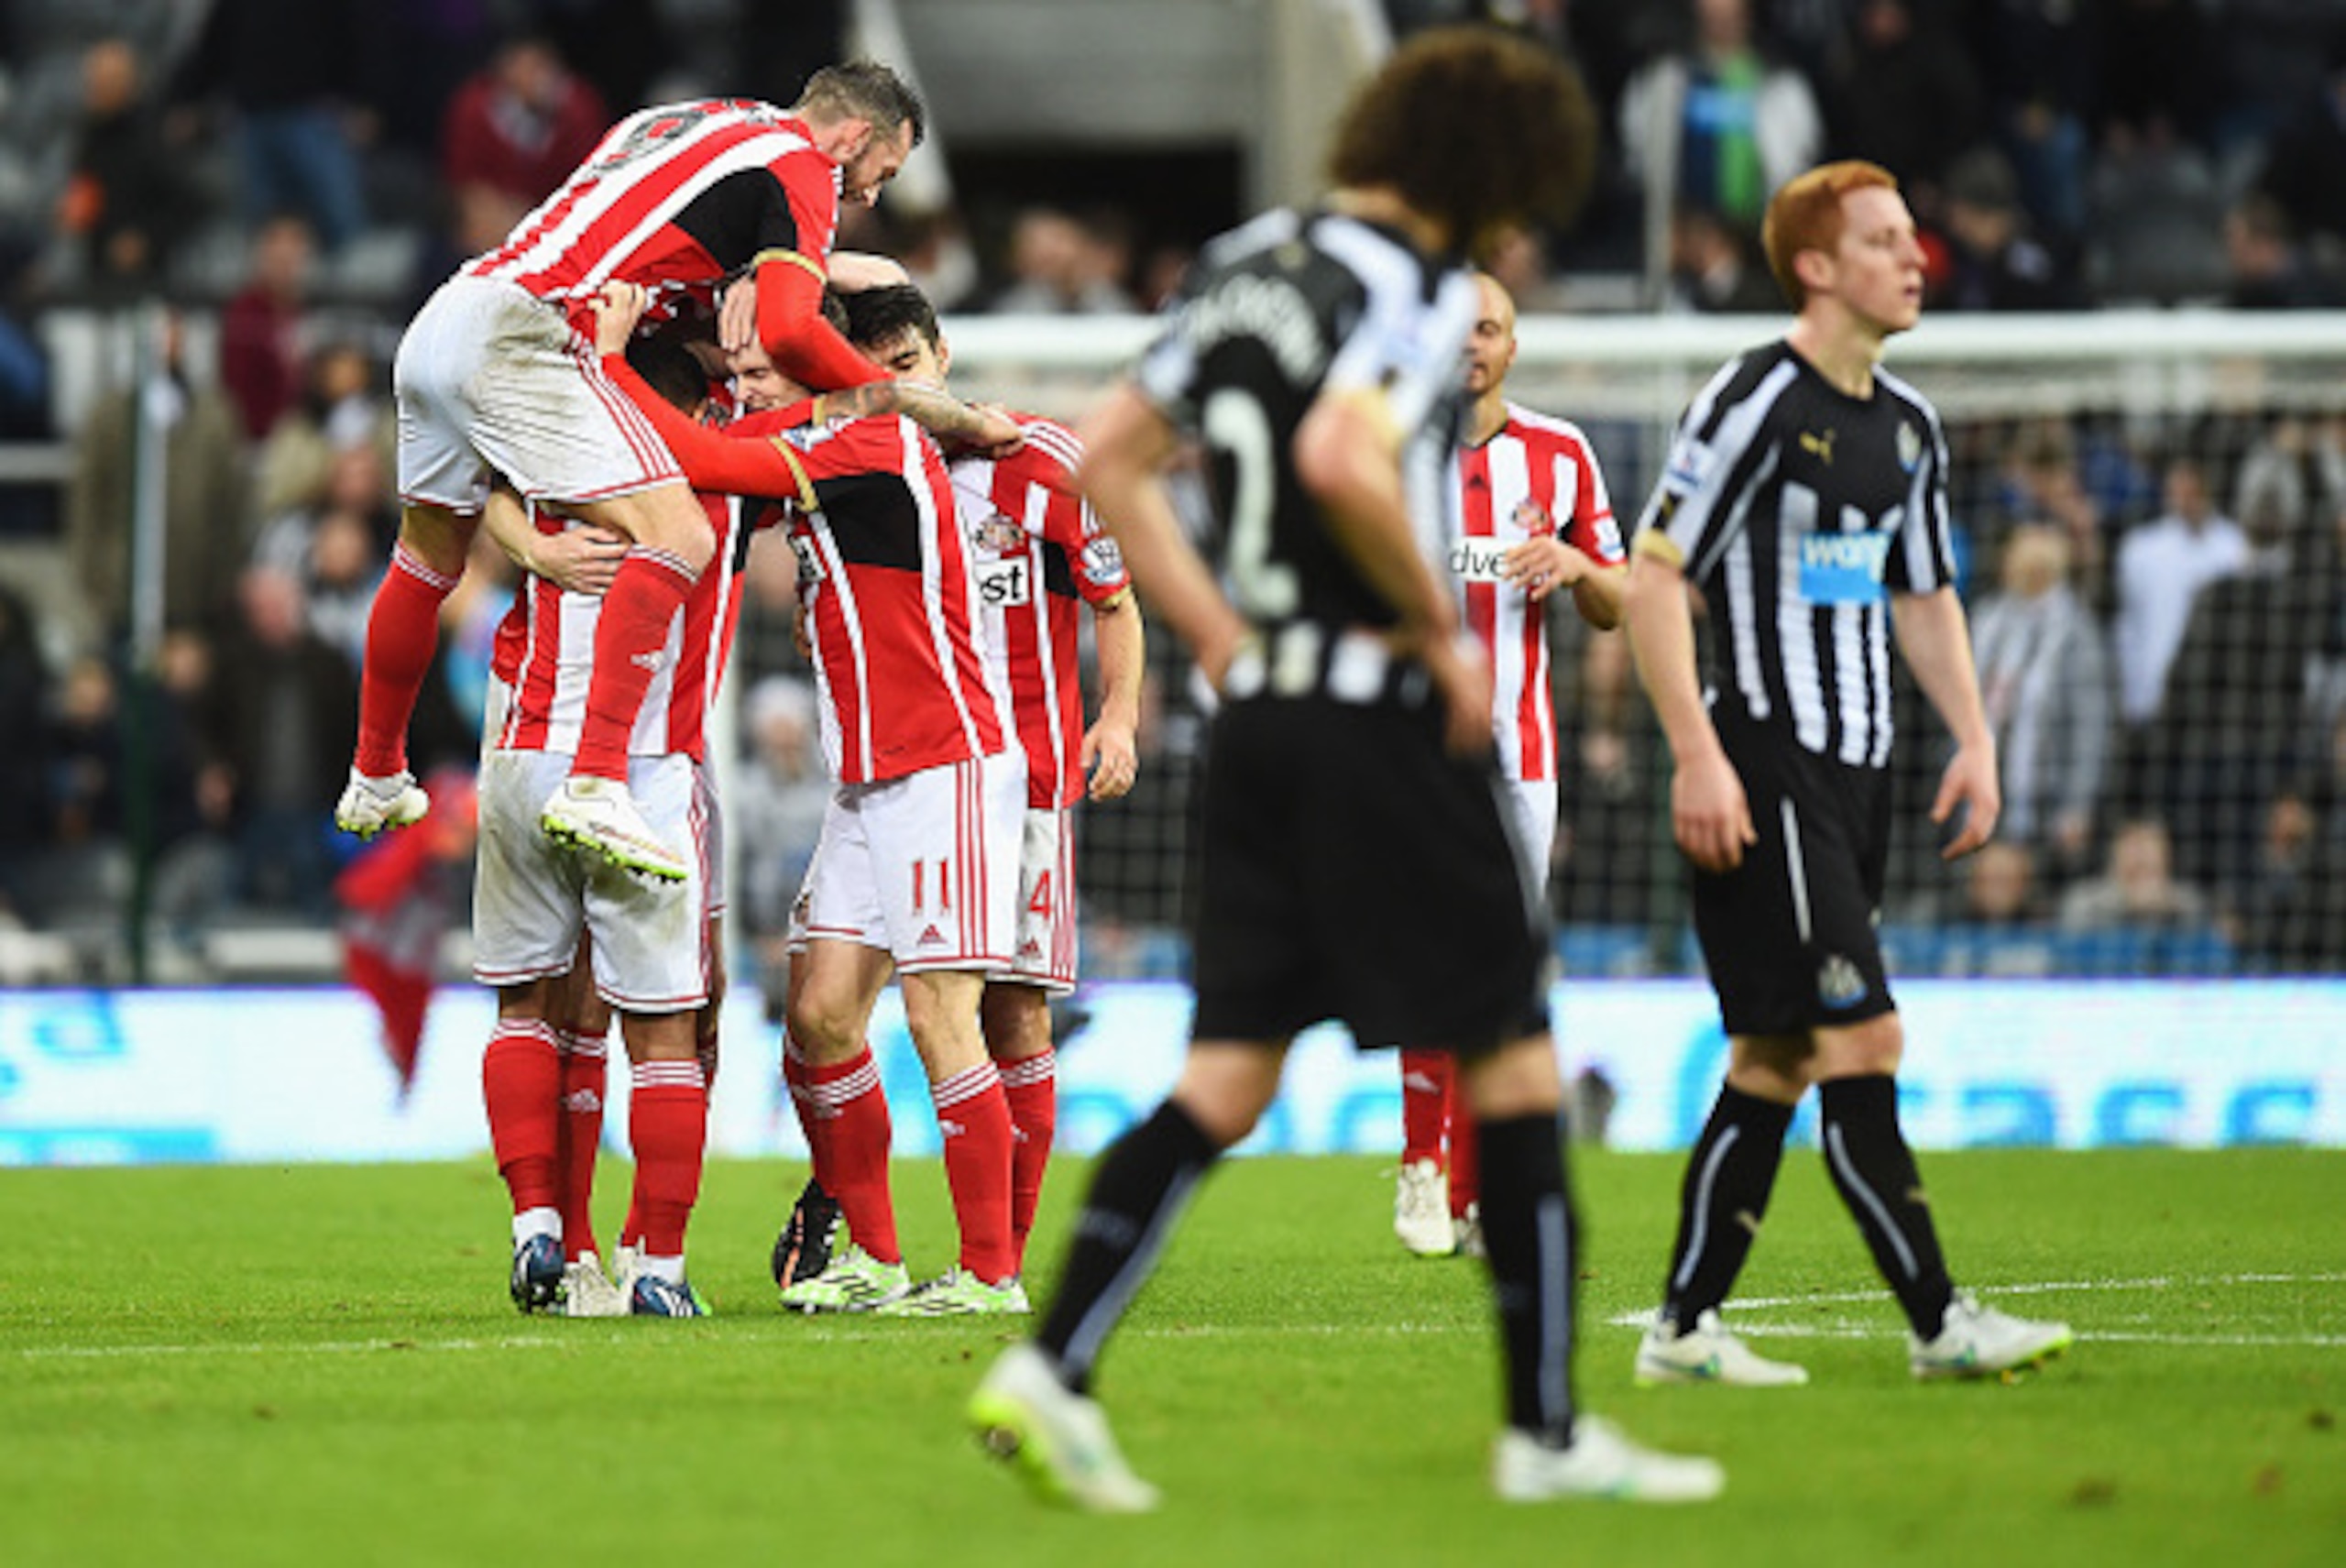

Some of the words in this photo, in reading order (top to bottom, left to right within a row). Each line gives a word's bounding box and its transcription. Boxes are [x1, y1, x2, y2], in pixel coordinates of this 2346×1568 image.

[1204, 387, 1299, 620] 2
[912, 857, 951, 916] 11
[1028, 868, 1051, 922] 4
